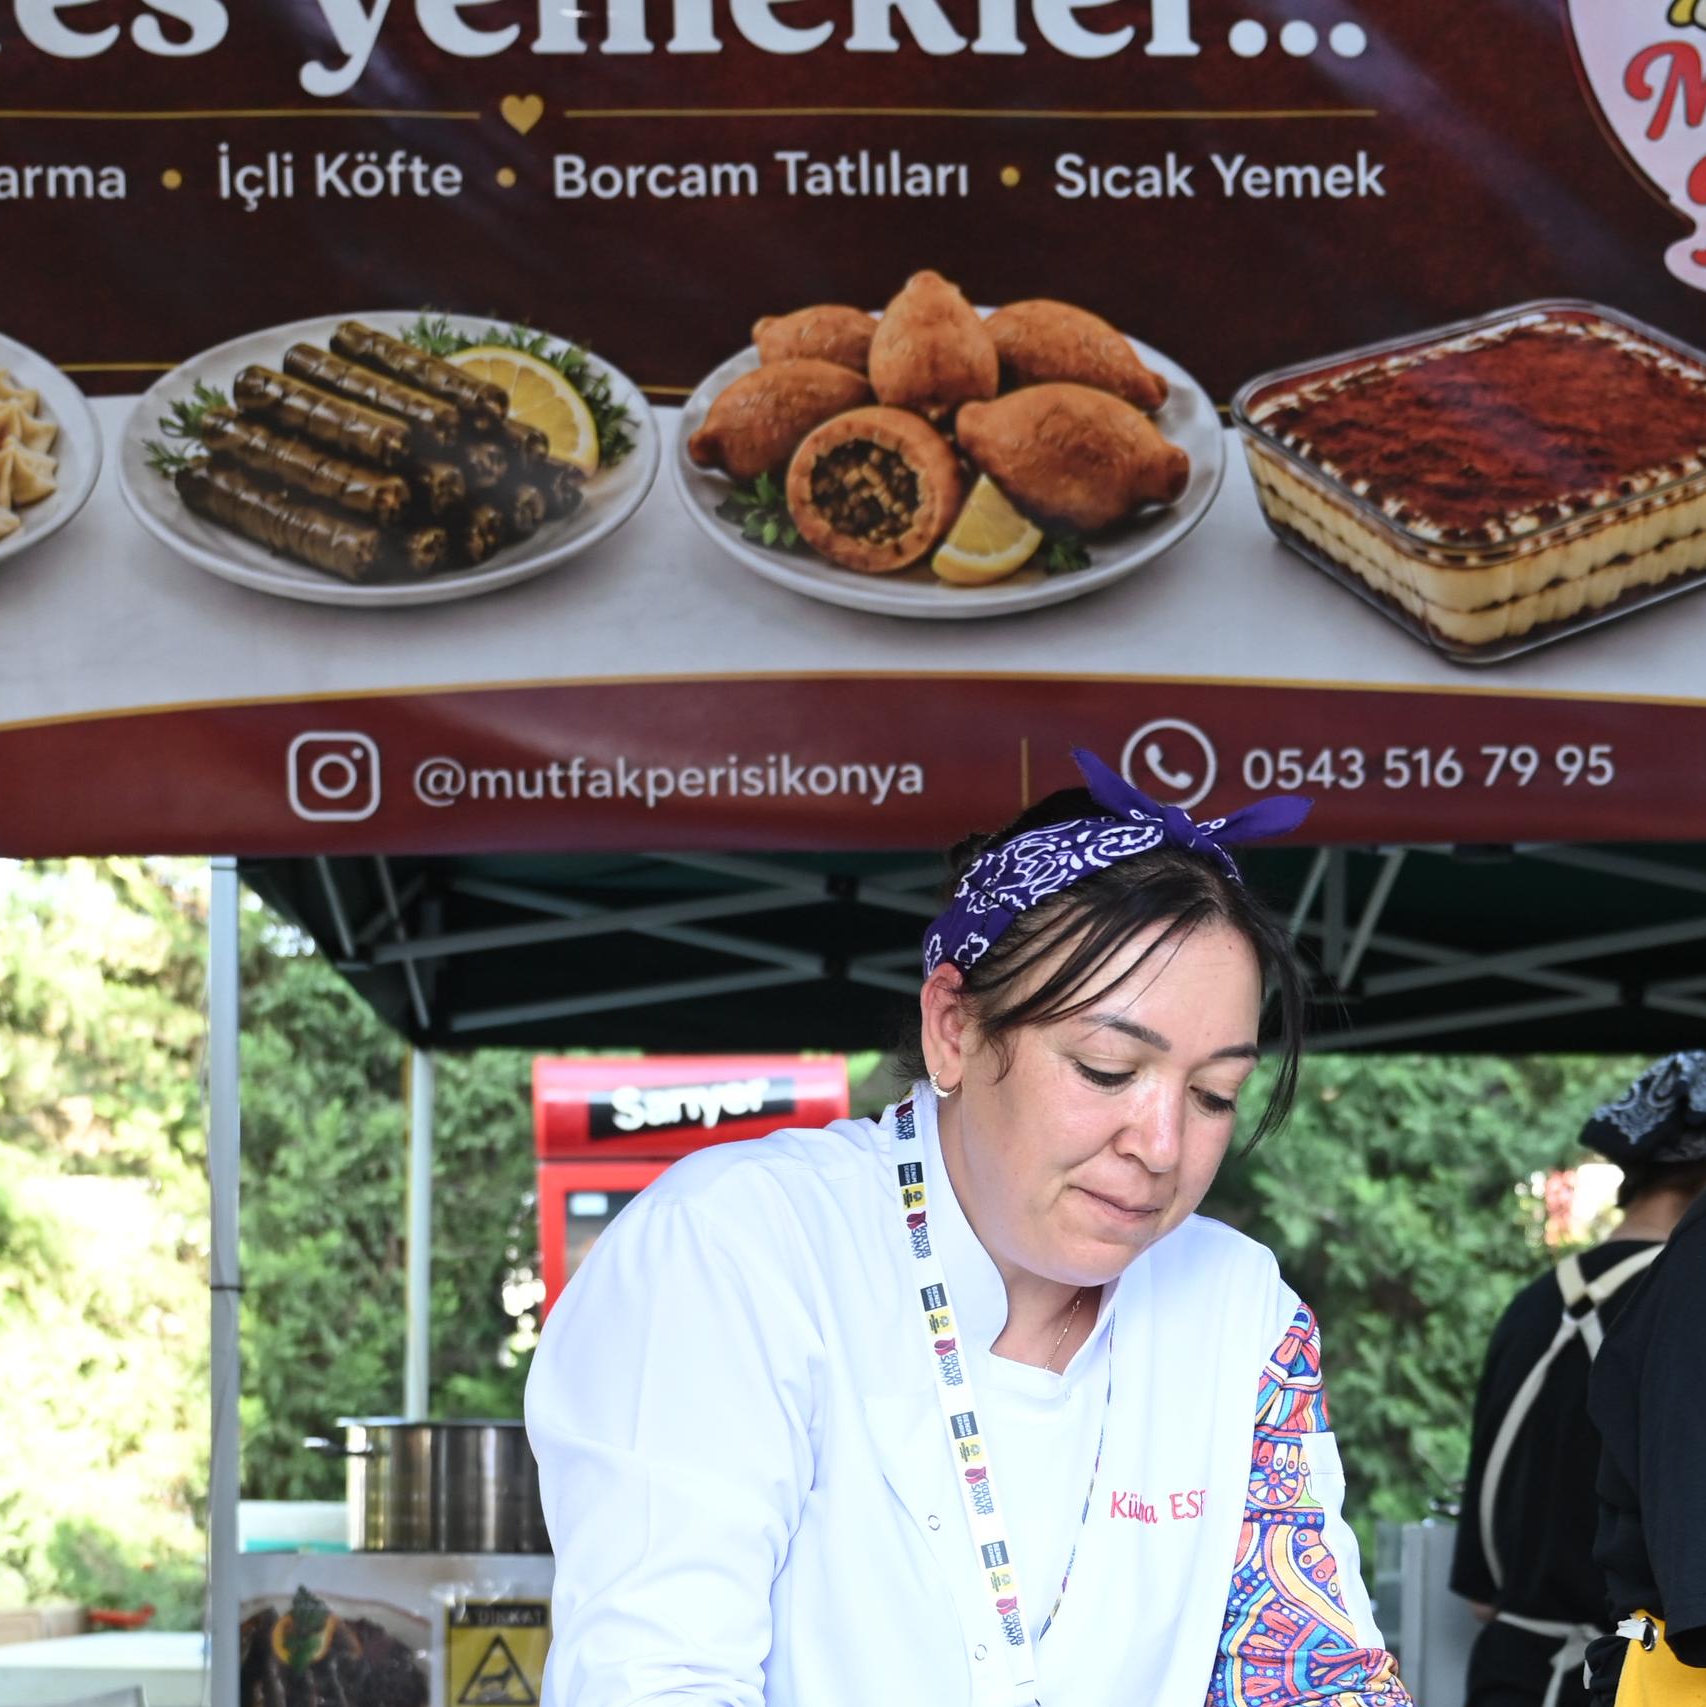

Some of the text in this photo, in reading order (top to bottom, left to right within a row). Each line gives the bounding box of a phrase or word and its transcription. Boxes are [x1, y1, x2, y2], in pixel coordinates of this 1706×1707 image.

[217, 143, 294, 212] İçli
[315, 150, 463, 199] Köfte
[554, 153, 758, 200] Borcam
[775, 150, 968, 198] Tatlıları
[1055, 151, 1195, 199] Sıcak
[1211, 151, 1385, 200] Yemek
[413, 758, 925, 806] @mutfakperisikonya
[1242, 743, 1615, 792] 0543 516 79 95
